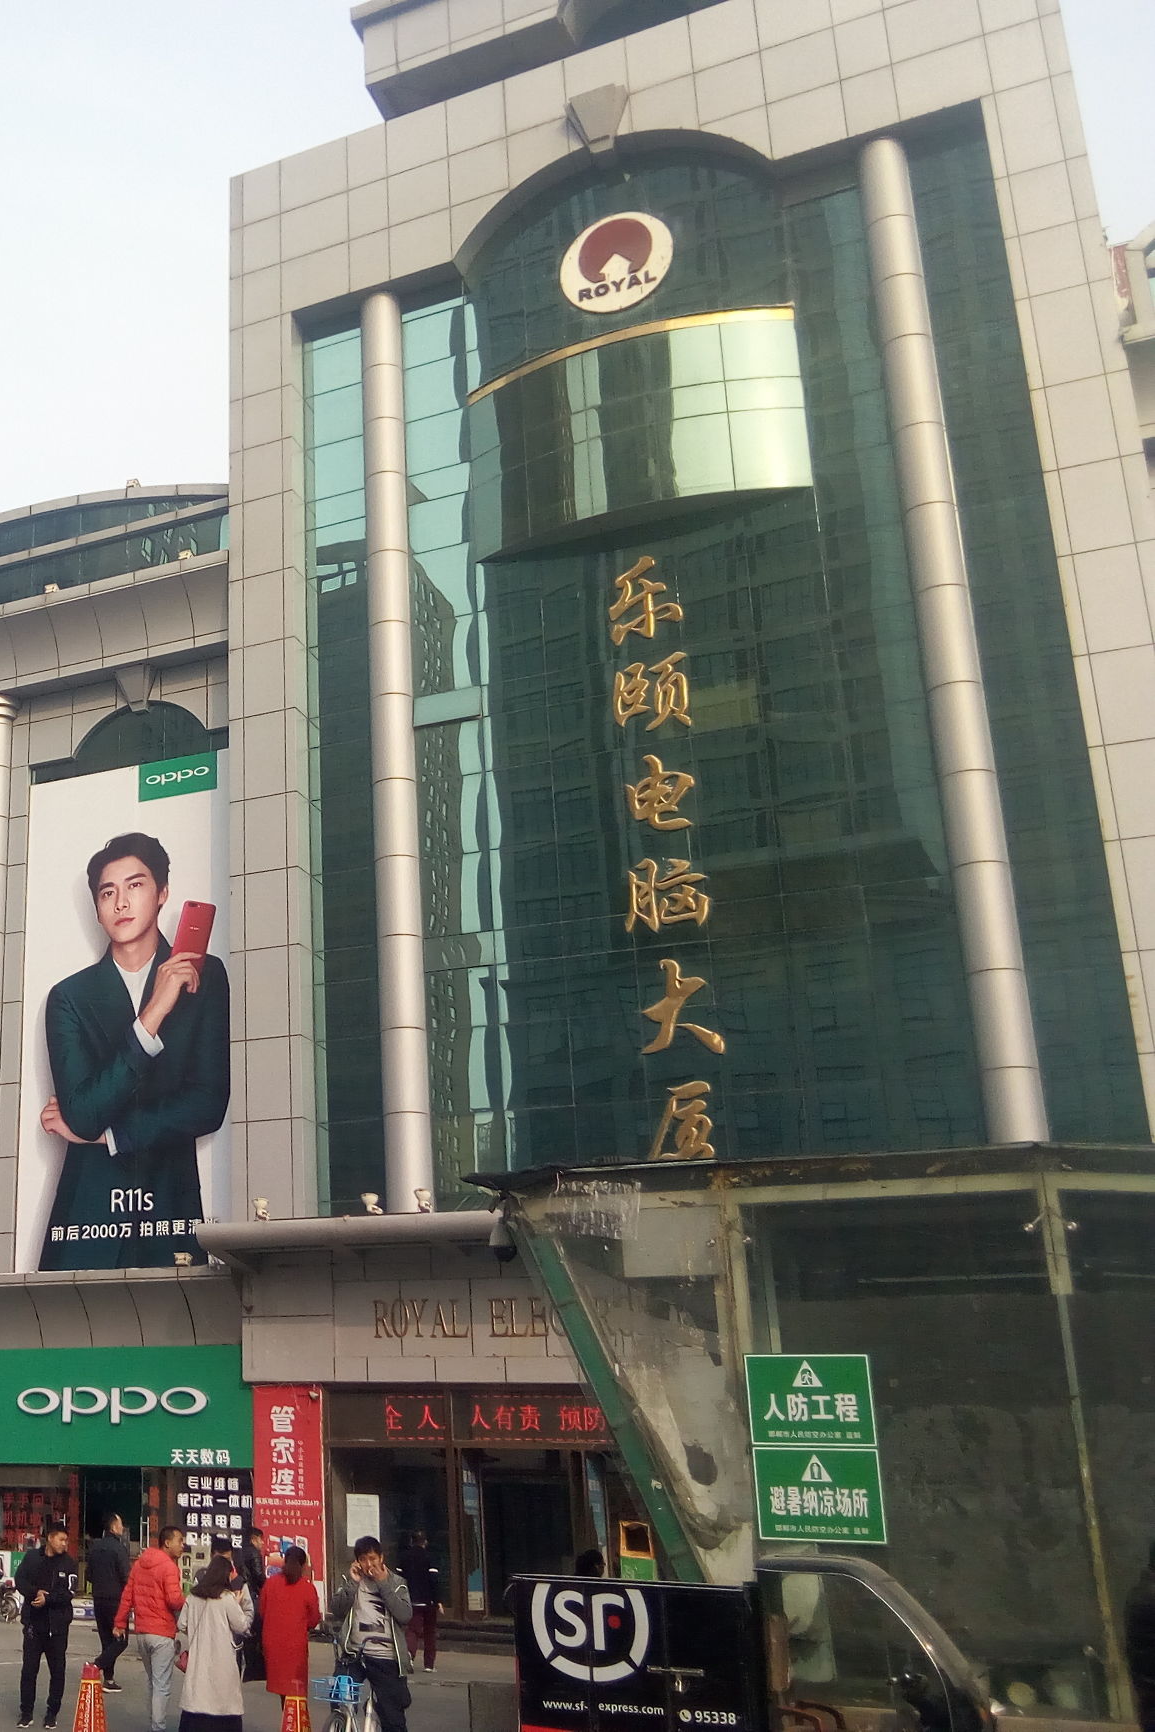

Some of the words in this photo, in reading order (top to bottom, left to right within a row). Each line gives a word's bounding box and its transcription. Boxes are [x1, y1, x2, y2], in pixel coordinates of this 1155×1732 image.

[578, 270, 657, 302] ROYAL
[145, 763, 210, 787] oppo
[109, 1189, 154, 1214] R11s
[50, 1222, 133, 1242] 前后2000万
[373, 1299, 469, 1338] ROYAL
[16, 1385, 209, 1424] oppo
[764, 1393, 860, 1422] 人防工程
[170, 1448, 231, 1466] 天天数码
[270, 1405, 296, 1495] 管家婆
[769, 1486, 869, 1518] 避暑纳凉场所
[185, 1531, 243, 1549] 配件发
[694, 1710, 737, 1725] 95338
